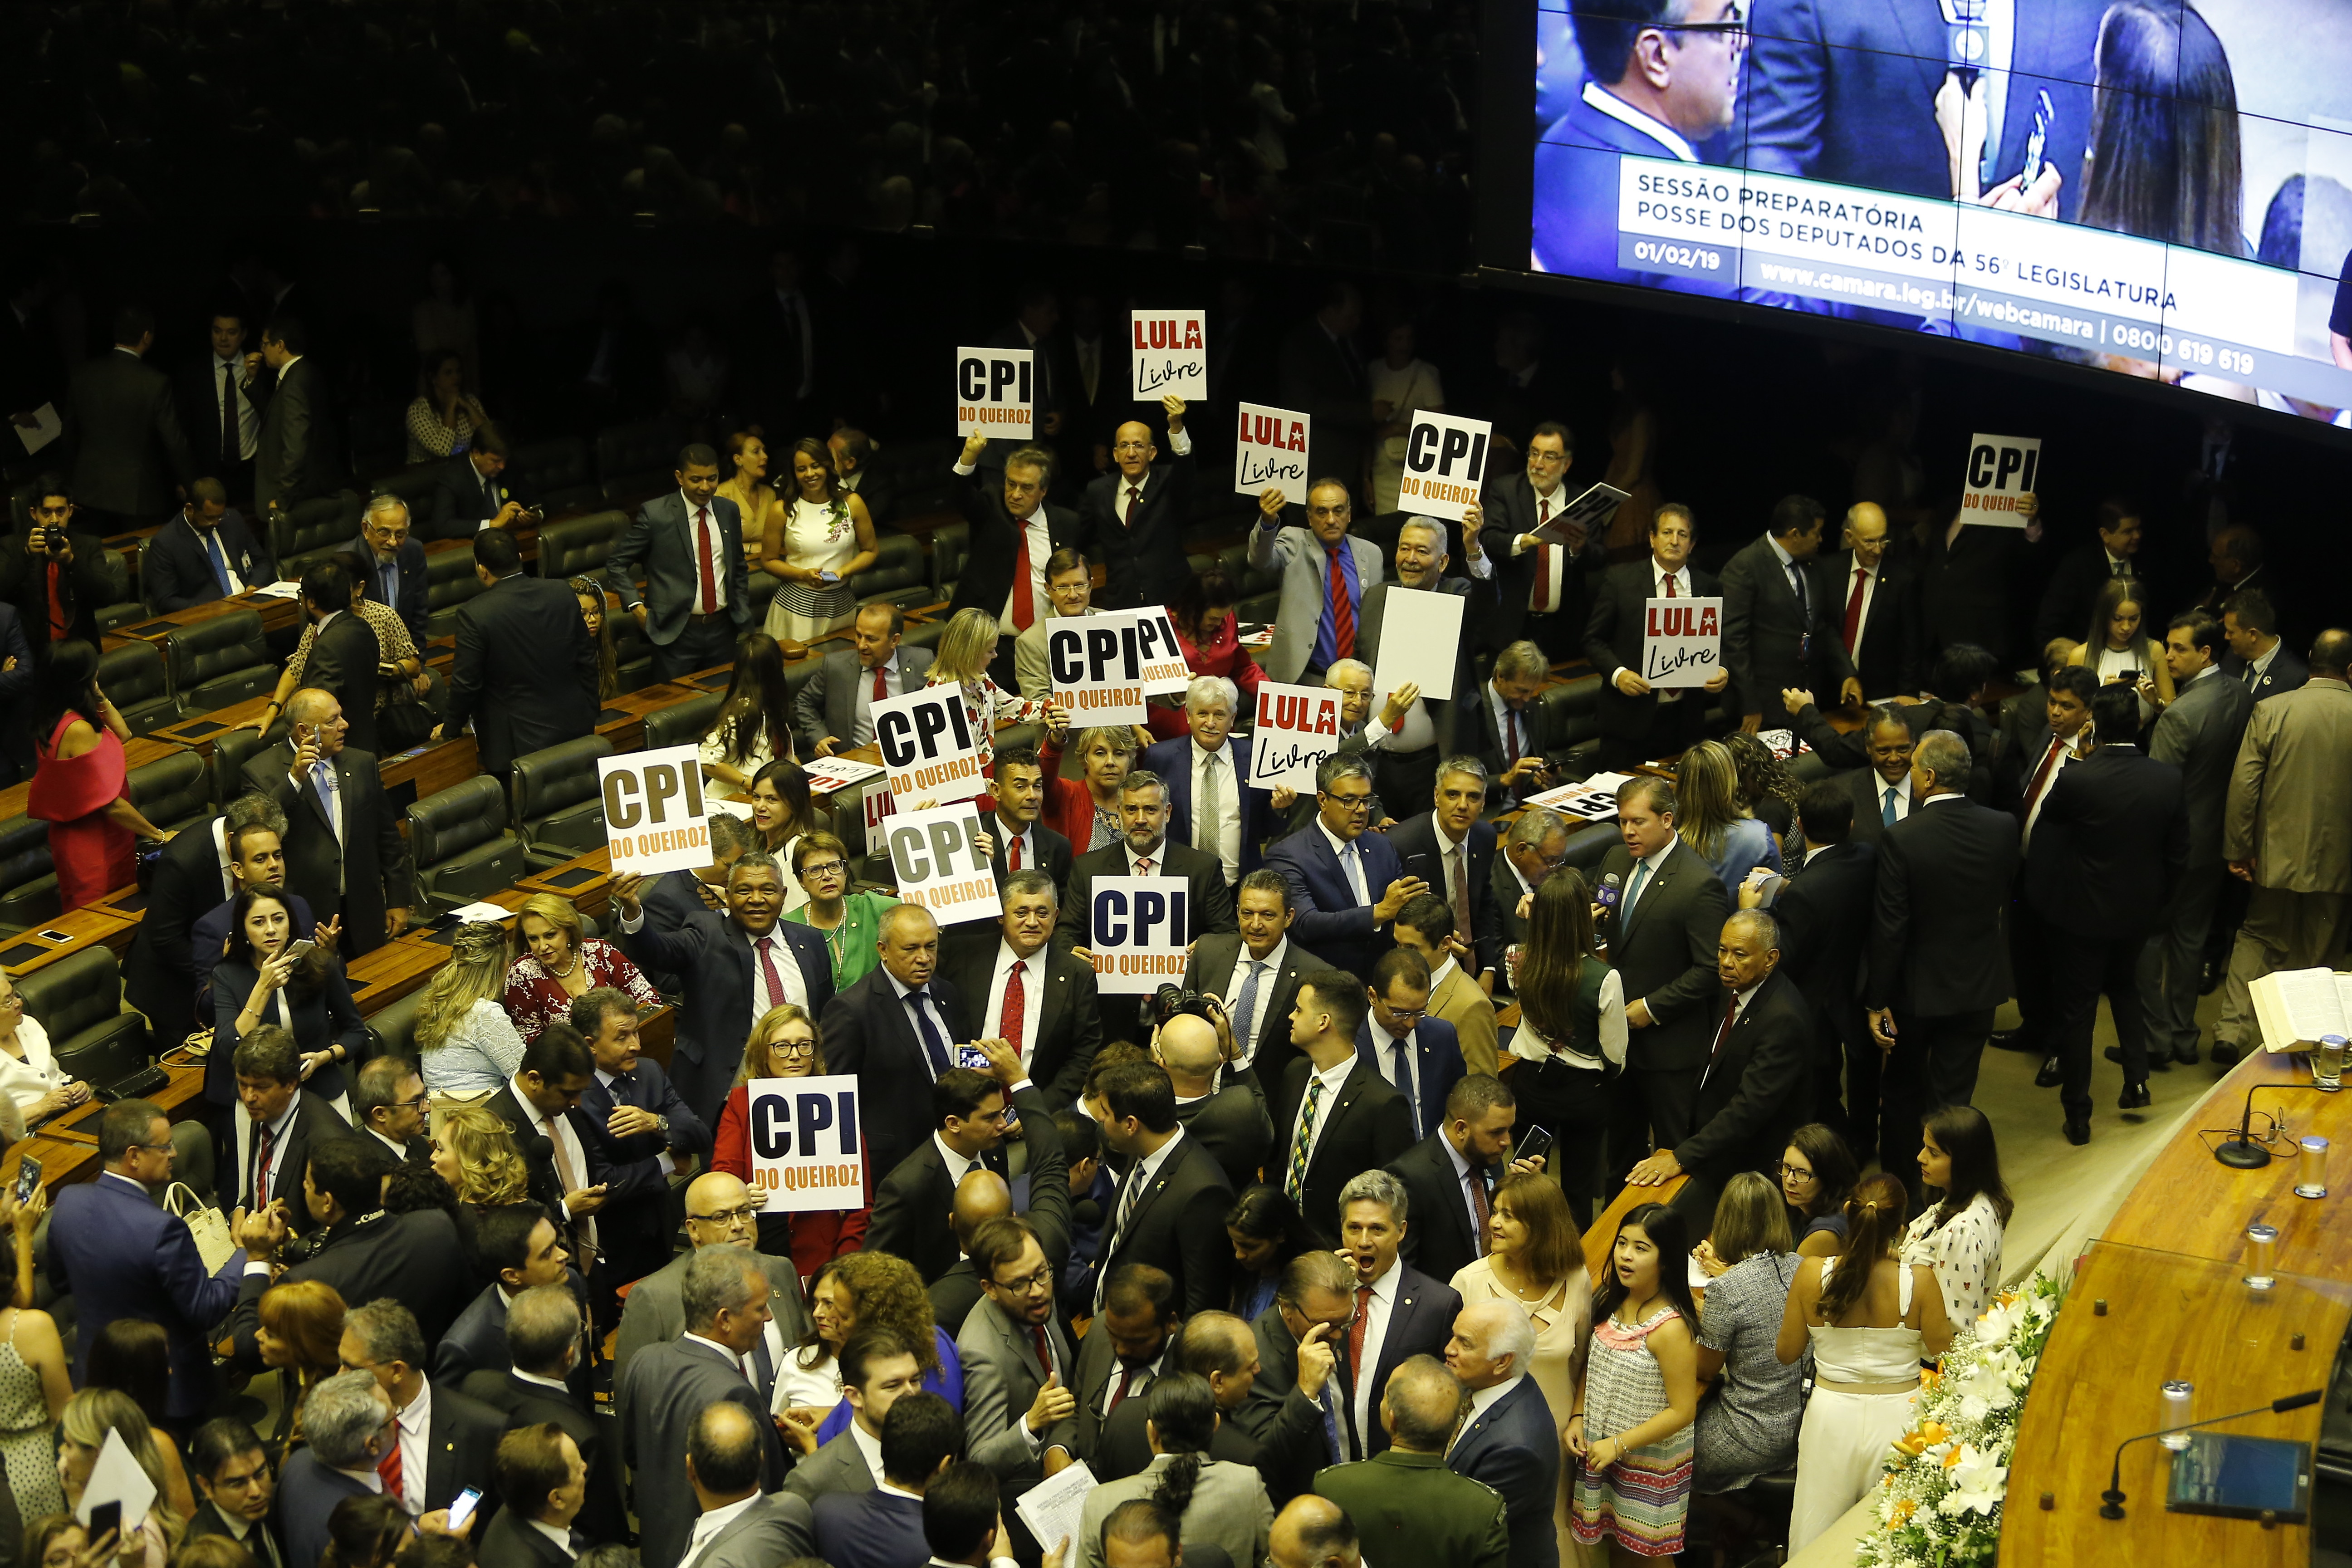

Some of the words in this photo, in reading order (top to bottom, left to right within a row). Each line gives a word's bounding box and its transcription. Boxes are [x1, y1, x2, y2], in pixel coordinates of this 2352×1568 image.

[1638, 174, 1730, 204] SESSÃO
[1739, 188, 1924, 234] PREPARATÓRIA
[1634, 240, 1721, 272] 01/02/19
[1638, 201, 1711, 227] POSSE
[1721, 213, 1770, 236] DOS
[1779, 222, 1922, 261] DEPUTADOS
[1932, 245, 1966, 268] DA
[2018, 262, 2177, 312] LEGISLATURA
[1134, 319, 1203, 349] LULA
[1760, 261, 2093, 340] www.camara.leg.br/webcamara
[2112, 323, 2174, 355] 0800
[2178, 338, 2214, 366] 619
[2218, 348, 2255, 376] 619
[959, 358, 1031, 403] CPI
[1138, 358, 1203, 393] Livre
[959, 406, 976, 422] DO
[979, 407, 1031, 424] QUEIROZ
[1240, 412, 1306, 453] LULA
[1240, 451, 1304, 485] Livre
[1407, 422, 1487, 482] CPI
[1969, 445, 2038, 492] CPI
[1401, 476, 1418, 496] DO
[1423, 480, 1478, 505] QUEIROZ
[1562, 490, 1621, 525] CPI
[1963, 493, 1980, 508] DO
[1982, 495, 2016, 511] QUEIR
[1137, 616, 1180, 660] PI
[1647, 607, 1718, 637] LULA
[1049, 627, 1140, 684] CPI
[1648, 645, 1716, 680] Livre
[1054, 691, 1074, 709] DO
[1078, 687, 1142, 710] QUEIROZ
[1258, 692, 1337, 735] LULA
[877, 695, 972, 768] CPI
[889, 774, 912, 796] DO
[915, 755, 980, 790] QUEIROZ
[1256, 738, 1327, 779] Livre
[603, 759, 705, 829] CPI
[808, 774, 849, 789] LU
[1537, 791, 1579, 806] QUEIROZ
[1577, 786, 1597, 796] DO
[1556, 792, 1618, 817] CPI
[610, 837, 634, 859] DO
[638, 825, 709, 857] QUEIROZ
[890, 816, 990, 883] CPI
[903, 890, 926, 908] DO
[929, 877, 996, 909] QUEIROZ
[1094, 890, 1186, 947] CPI
[1094, 954, 1114, 974] DO
[1119, 955, 1186, 976] QUEIROZ
[752, 1091, 858, 1159] CPI
[755, 1167, 779, 1190] DO
[784, 1164, 860, 1191] QUEIROZ
